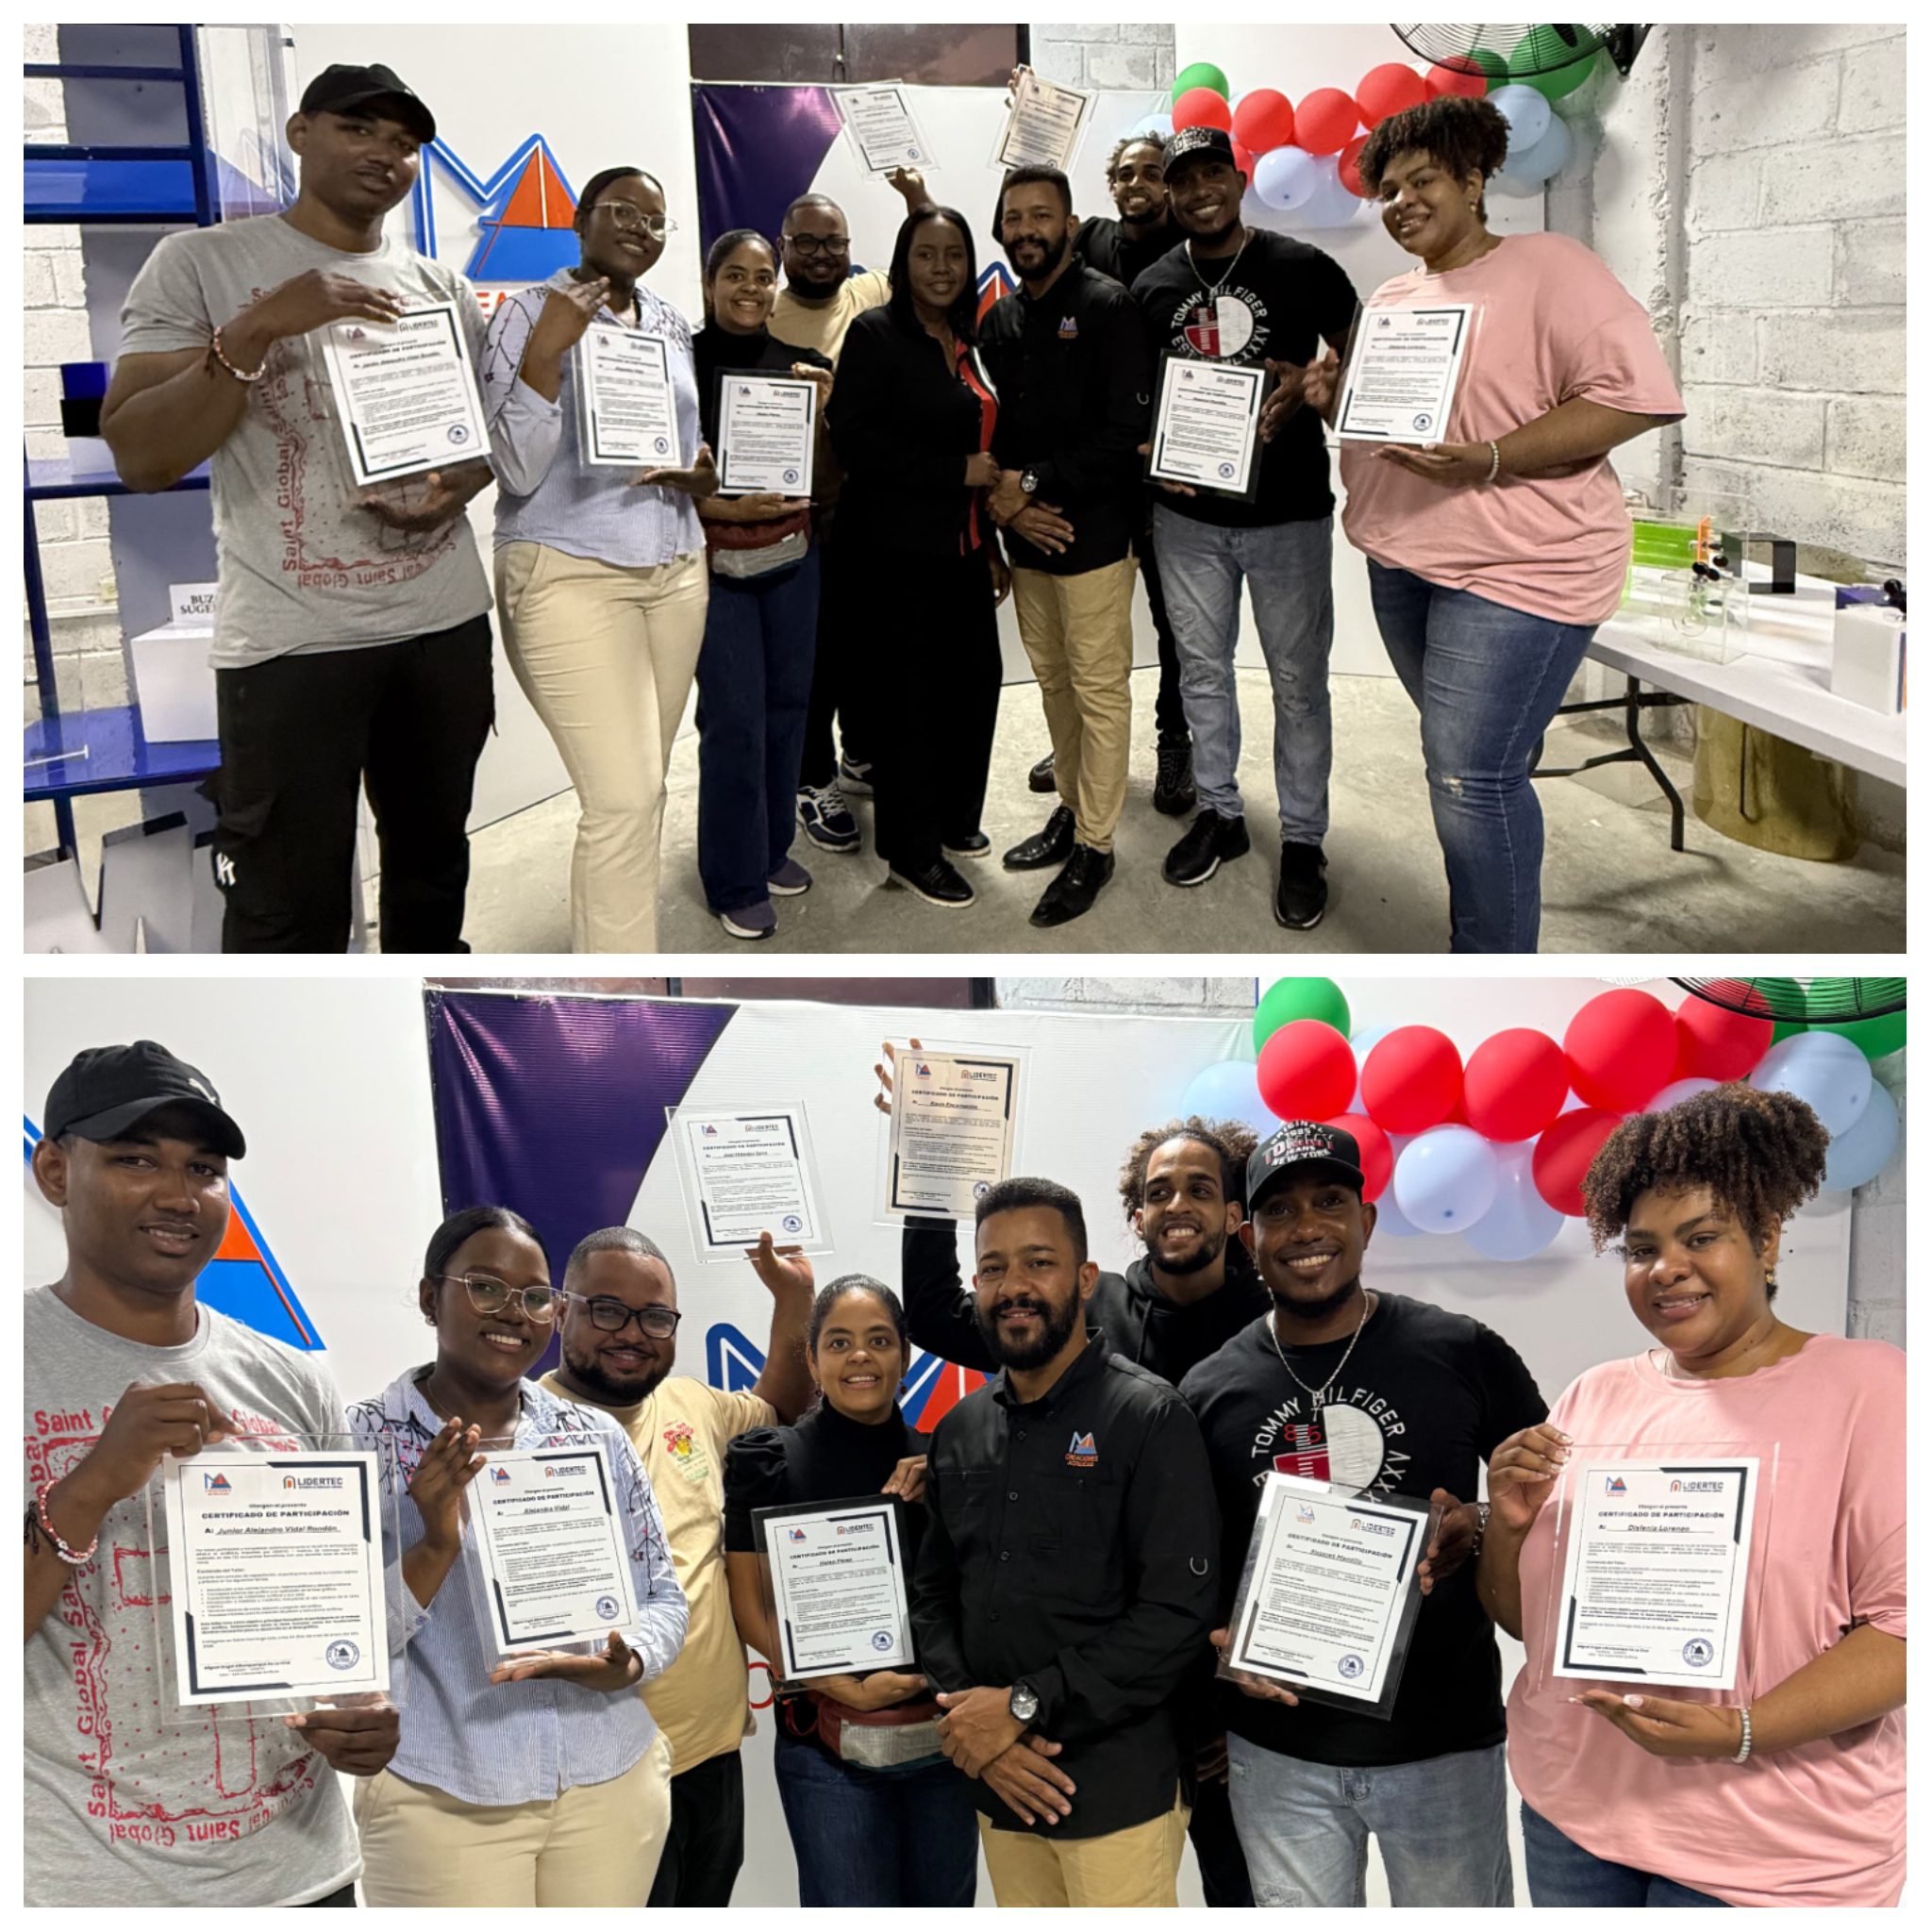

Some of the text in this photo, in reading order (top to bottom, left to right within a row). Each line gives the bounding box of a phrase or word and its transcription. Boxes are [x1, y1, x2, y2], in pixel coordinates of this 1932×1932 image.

[1171, 291, 1204, 329] TOMMY
[276, 442, 291, 508] Global
[281, 520, 297, 571] Saint
[298, 568, 396, 589] Saint Global
[1271, 1148, 1332, 1167] NEW YORK
[34, 1408, 94, 1436] Saint
[1251, 1386, 1406, 1458] TOMMY HILFIGER
[297, 1476, 343, 1487] LIDERTEC
[1683, 1481, 1724, 1491] LIDERTEC
[202, 1511, 263, 1520] CERTIFICADO
[280, 1509, 350, 1518] PARTICIPACIÓN
[70, 1641, 95, 1735] Global
[77, 1752, 107, 1817] Saint
[109, 1820, 240, 1848] Saint Global
